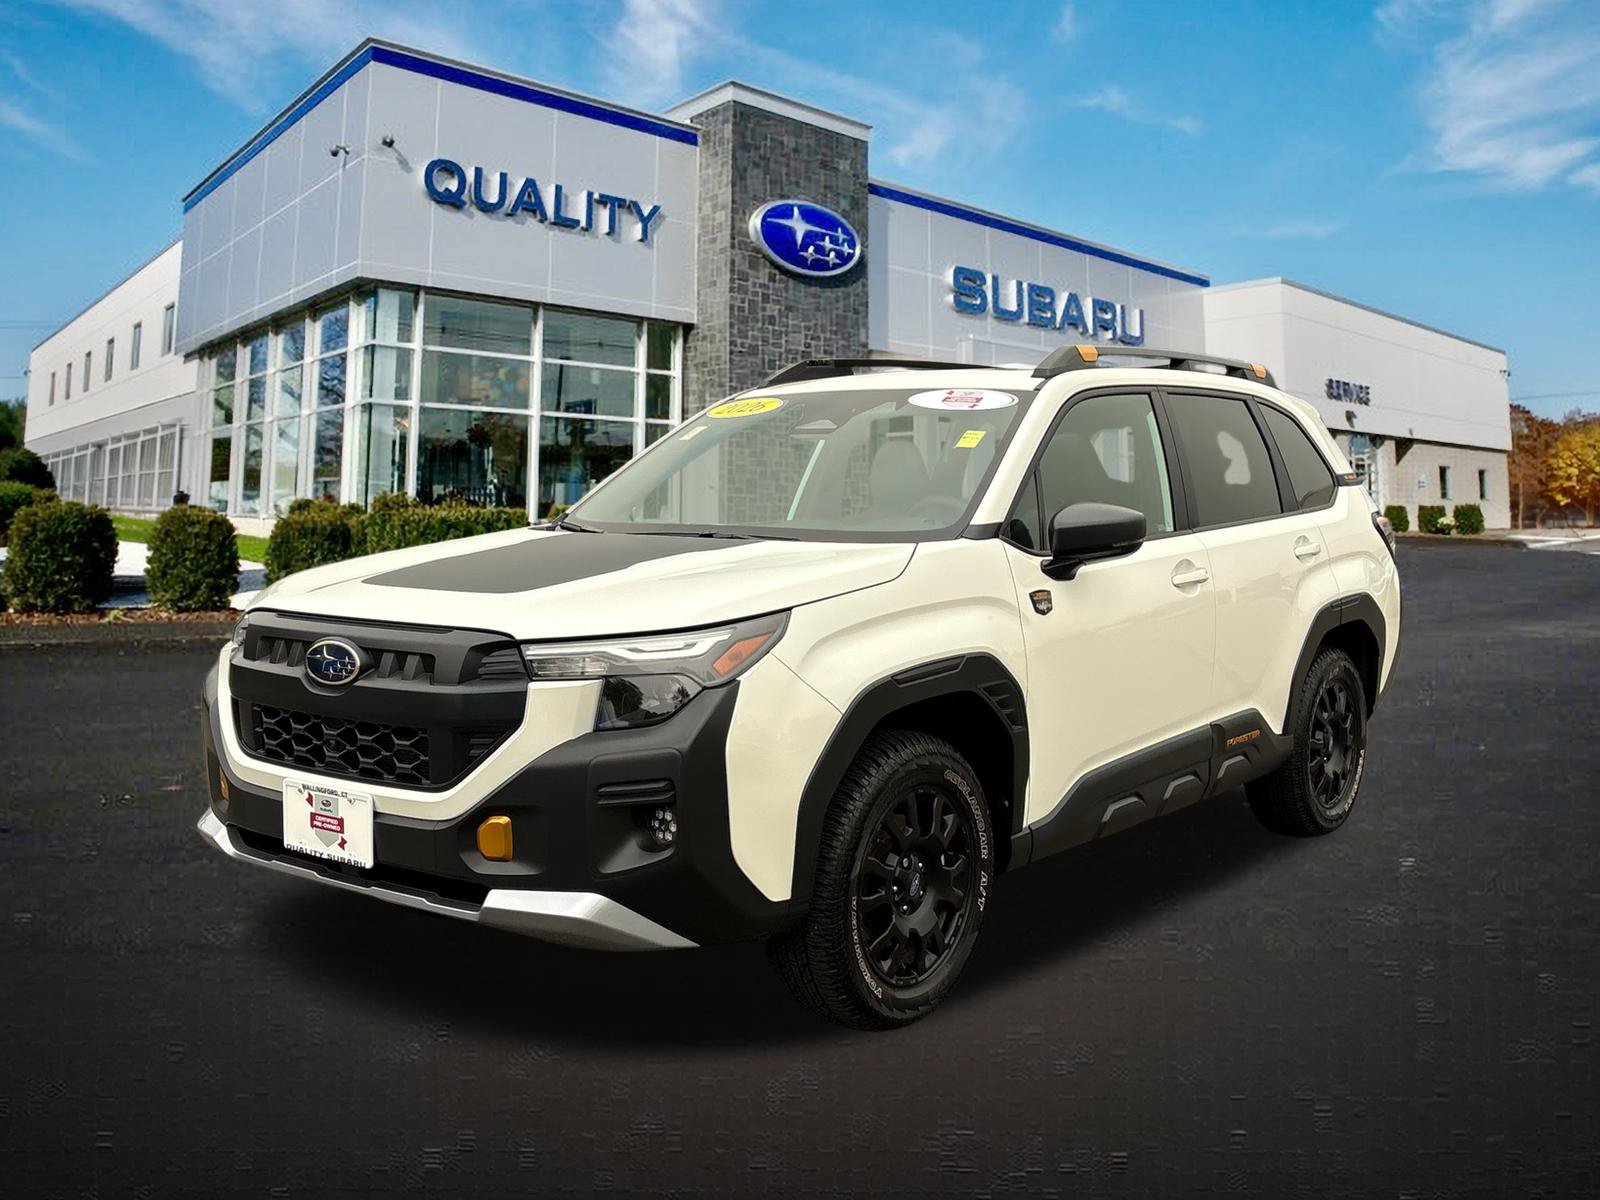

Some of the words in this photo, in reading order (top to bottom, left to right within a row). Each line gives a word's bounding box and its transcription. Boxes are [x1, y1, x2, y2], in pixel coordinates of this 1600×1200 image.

[424, 158, 661, 243] QUALITY
[951, 265, 1144, 346] SUBARU
[1326, 377, 1370, 406] SERVICE
[1226, 729, 1261, 748] FORESTER
[313, 820, 341, 831] PRE-OWNED
[314, 815, 339, 825] CERTIFIED
[327, 852, 367, 868] SUBARU
